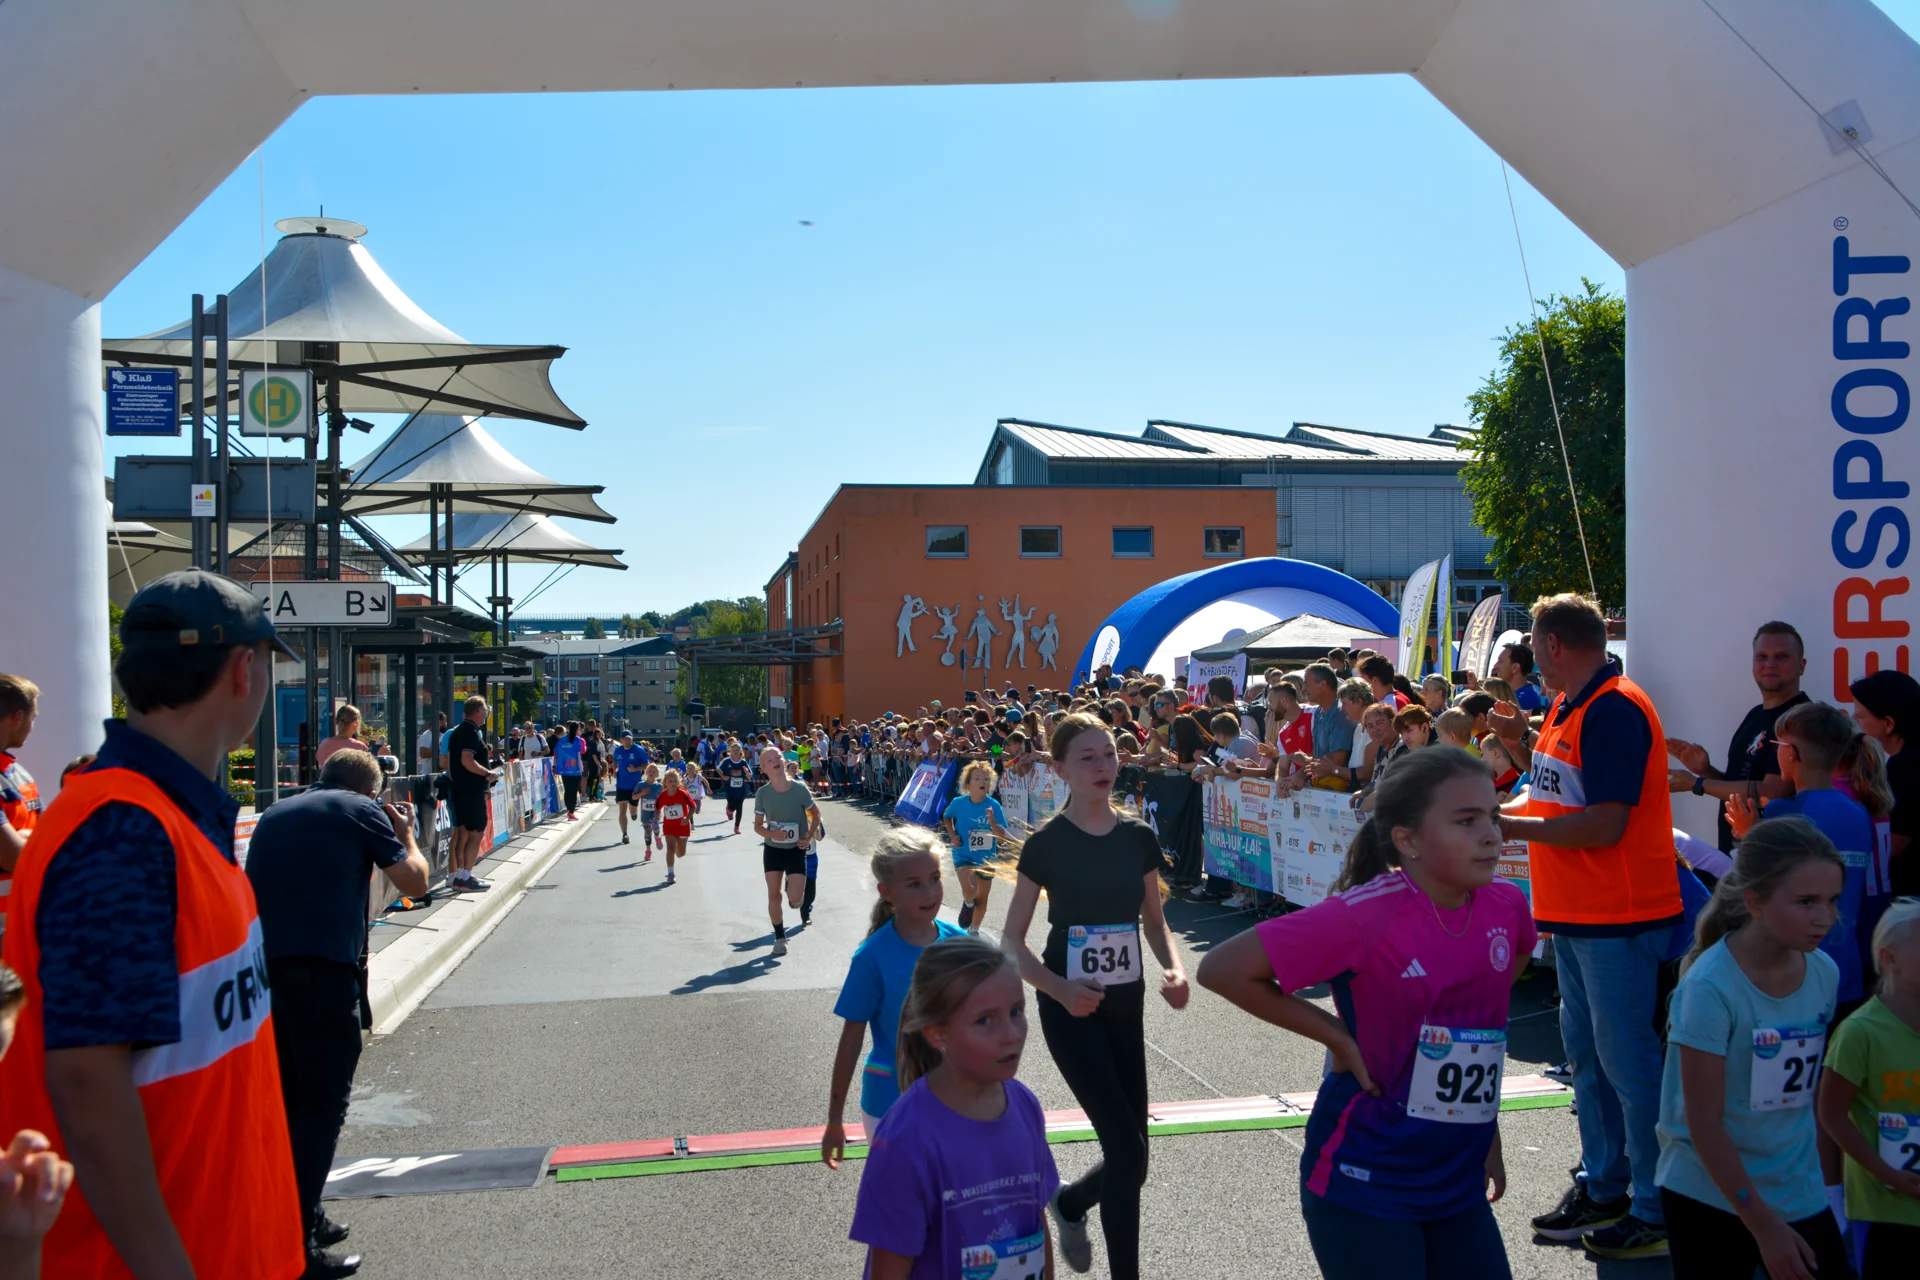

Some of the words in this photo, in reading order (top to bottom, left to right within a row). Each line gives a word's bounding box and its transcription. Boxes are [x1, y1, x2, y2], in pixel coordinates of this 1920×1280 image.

[128, 374, 152, 382] Klaß
[266, 388, 286, 416] H
[275, 591, 297, 616] A
[346, 591, 365, 616] B
[971, 837, 984, 846] 28
[1513, 865, 1528, 877] 2025
[1081, 945, 1131, 974] 634
[1436, 1062, 1498, 1104] 923
